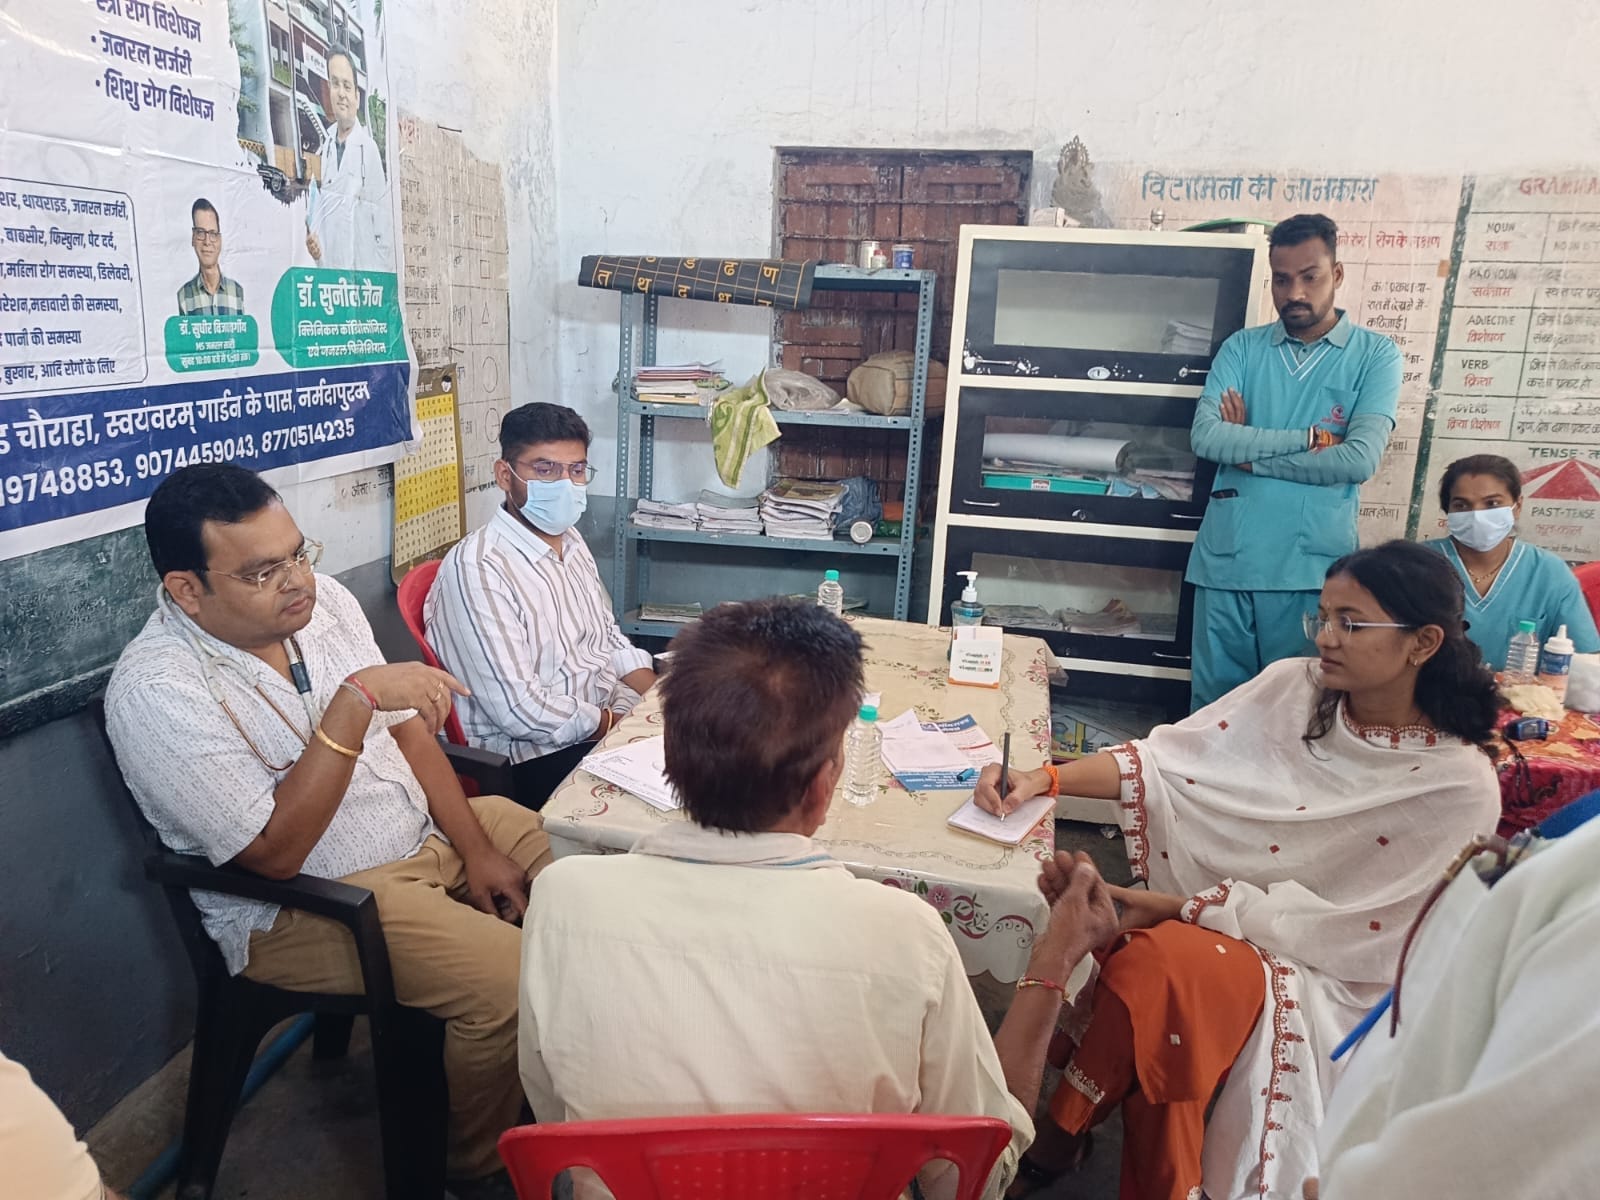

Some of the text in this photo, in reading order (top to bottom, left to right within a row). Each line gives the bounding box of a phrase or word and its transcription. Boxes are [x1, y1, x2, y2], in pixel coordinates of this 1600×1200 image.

[99, 30, 192, 75] जनरल सर्जरी
[104, 68, 214, 121] शिशु रोग विशेषज्ञ
[70, 199, 101, 215] जनरल
[102, 201, 129, 221] सर्जरी,
[1487, 222, 1516, 234] NOUN
[87, 229, 100, 248] पेट
[101, 231, 117, 251] दर्द,
[39, 260, 57, 278] रोग
[57, 264, 96, 282] समस्या,
[97, 262, 133, 282] डिलेवरी,
[723, 260, 738, 277] ढ
[762, 264, 779, 286] ण
[596, 269, 613, 288] त
[636, 276, 653, 294] थ
[677, 283, 691, 299] द
[71, 294, 85, 312] की
[86, 297, 123, 314] समस्या,
[297, 275, 317, 307] डॉ.
[318, 277, 361, 316] सुनील
[361, 277, 384, 307] जैन
[4, 328, 29, 347] पानी
[30, 327, 45, 346] की
[45, 330, 82, 345] समस्या
[178, 319, 191, 336] डॉ.
[40, 359, 63, 378] आदि
[63, 358, 85, 376] रोगों
[85, 358, 96, 374] के
[96, 357, 116, 374] लिए
[1461, 359, 1489, 370] VERB
[12, 408, 101, 450] चौराहा,
[103, 399, 197, 439] स्वयंवरम्
[195, 388, 242, 424] गार्डन
[243, 386, 262, 417] के
[263, 388, 297, 414] पास,
[295, 378, 371, 413] नर्मदापुरम
[134, 434, 260, 482] 9074459043,
[261, 417, 356, 454] 8770514235
[1528, 447, 1578, 459] TENSE
